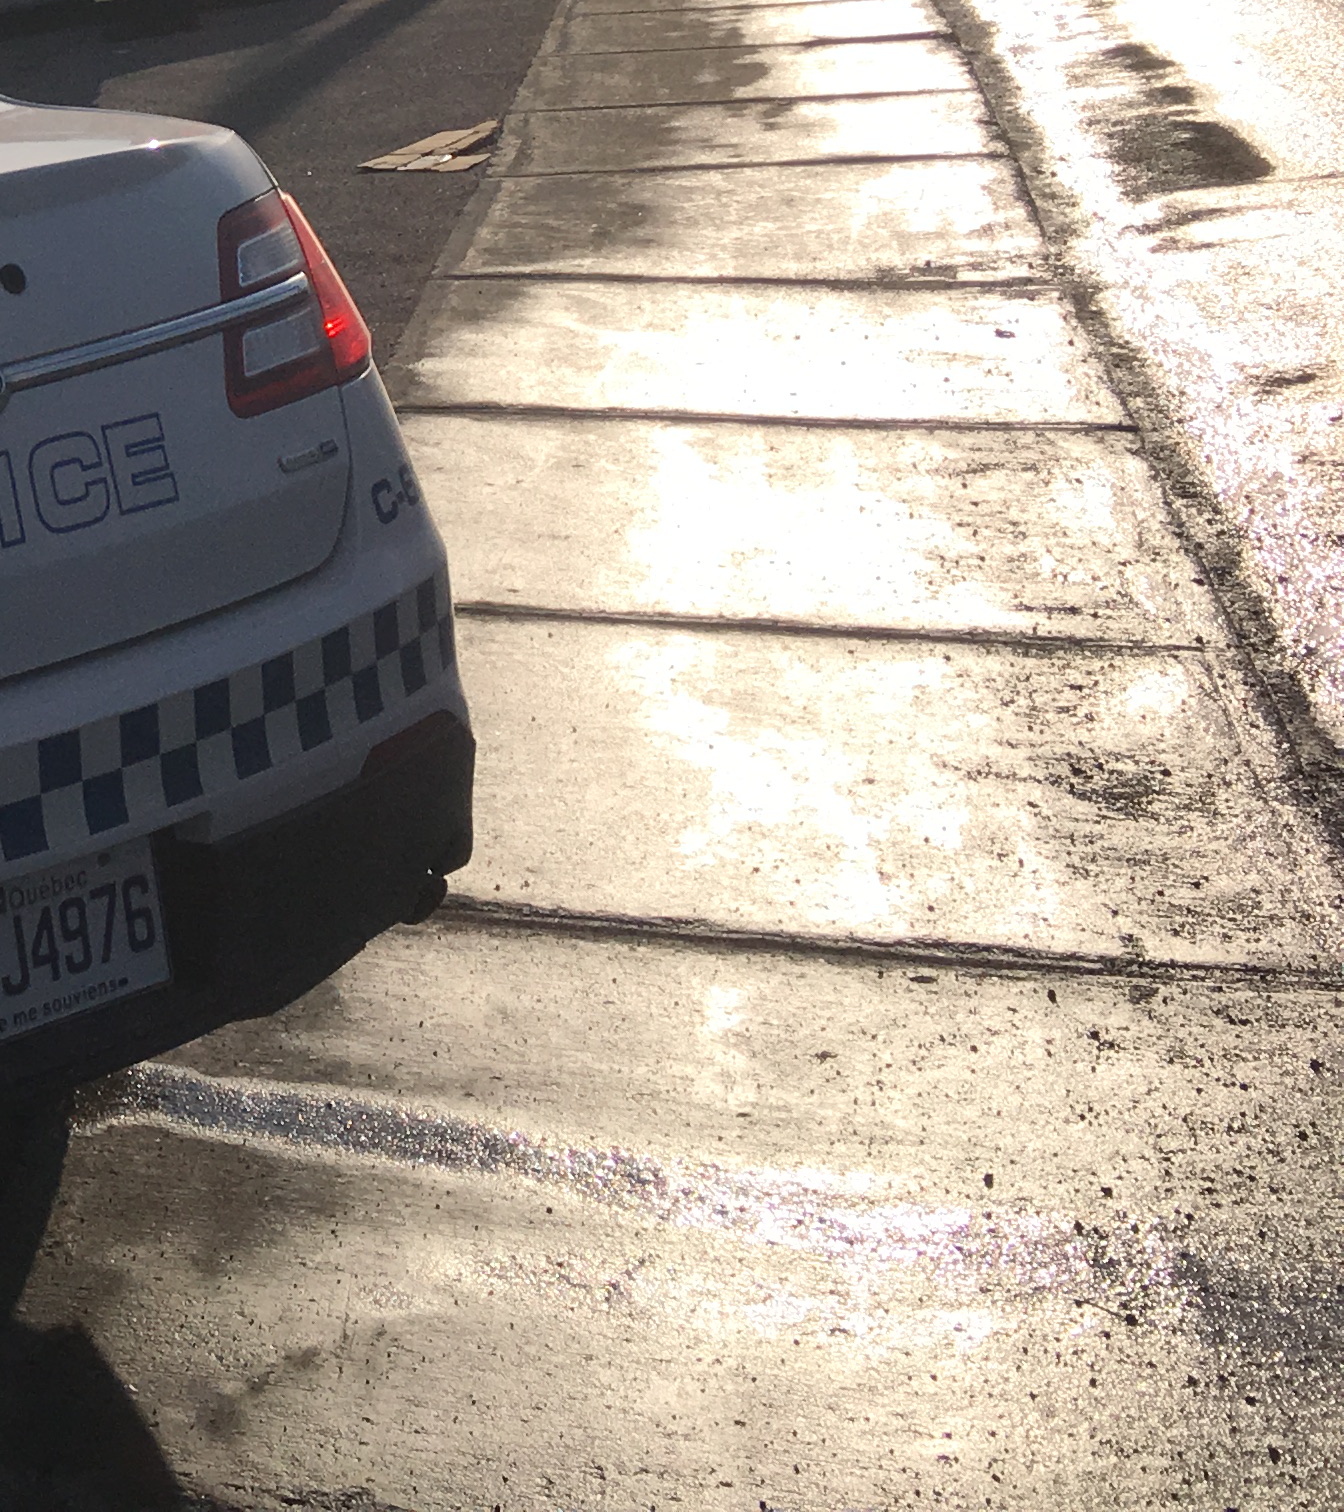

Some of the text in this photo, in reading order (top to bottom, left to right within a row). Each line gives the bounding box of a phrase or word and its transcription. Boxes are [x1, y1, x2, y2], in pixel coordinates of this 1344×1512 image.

[9, 870, 88, 908] Québec
[14, 1009, 38, 1026] me
[43, 977, 118, 1014] souviens
